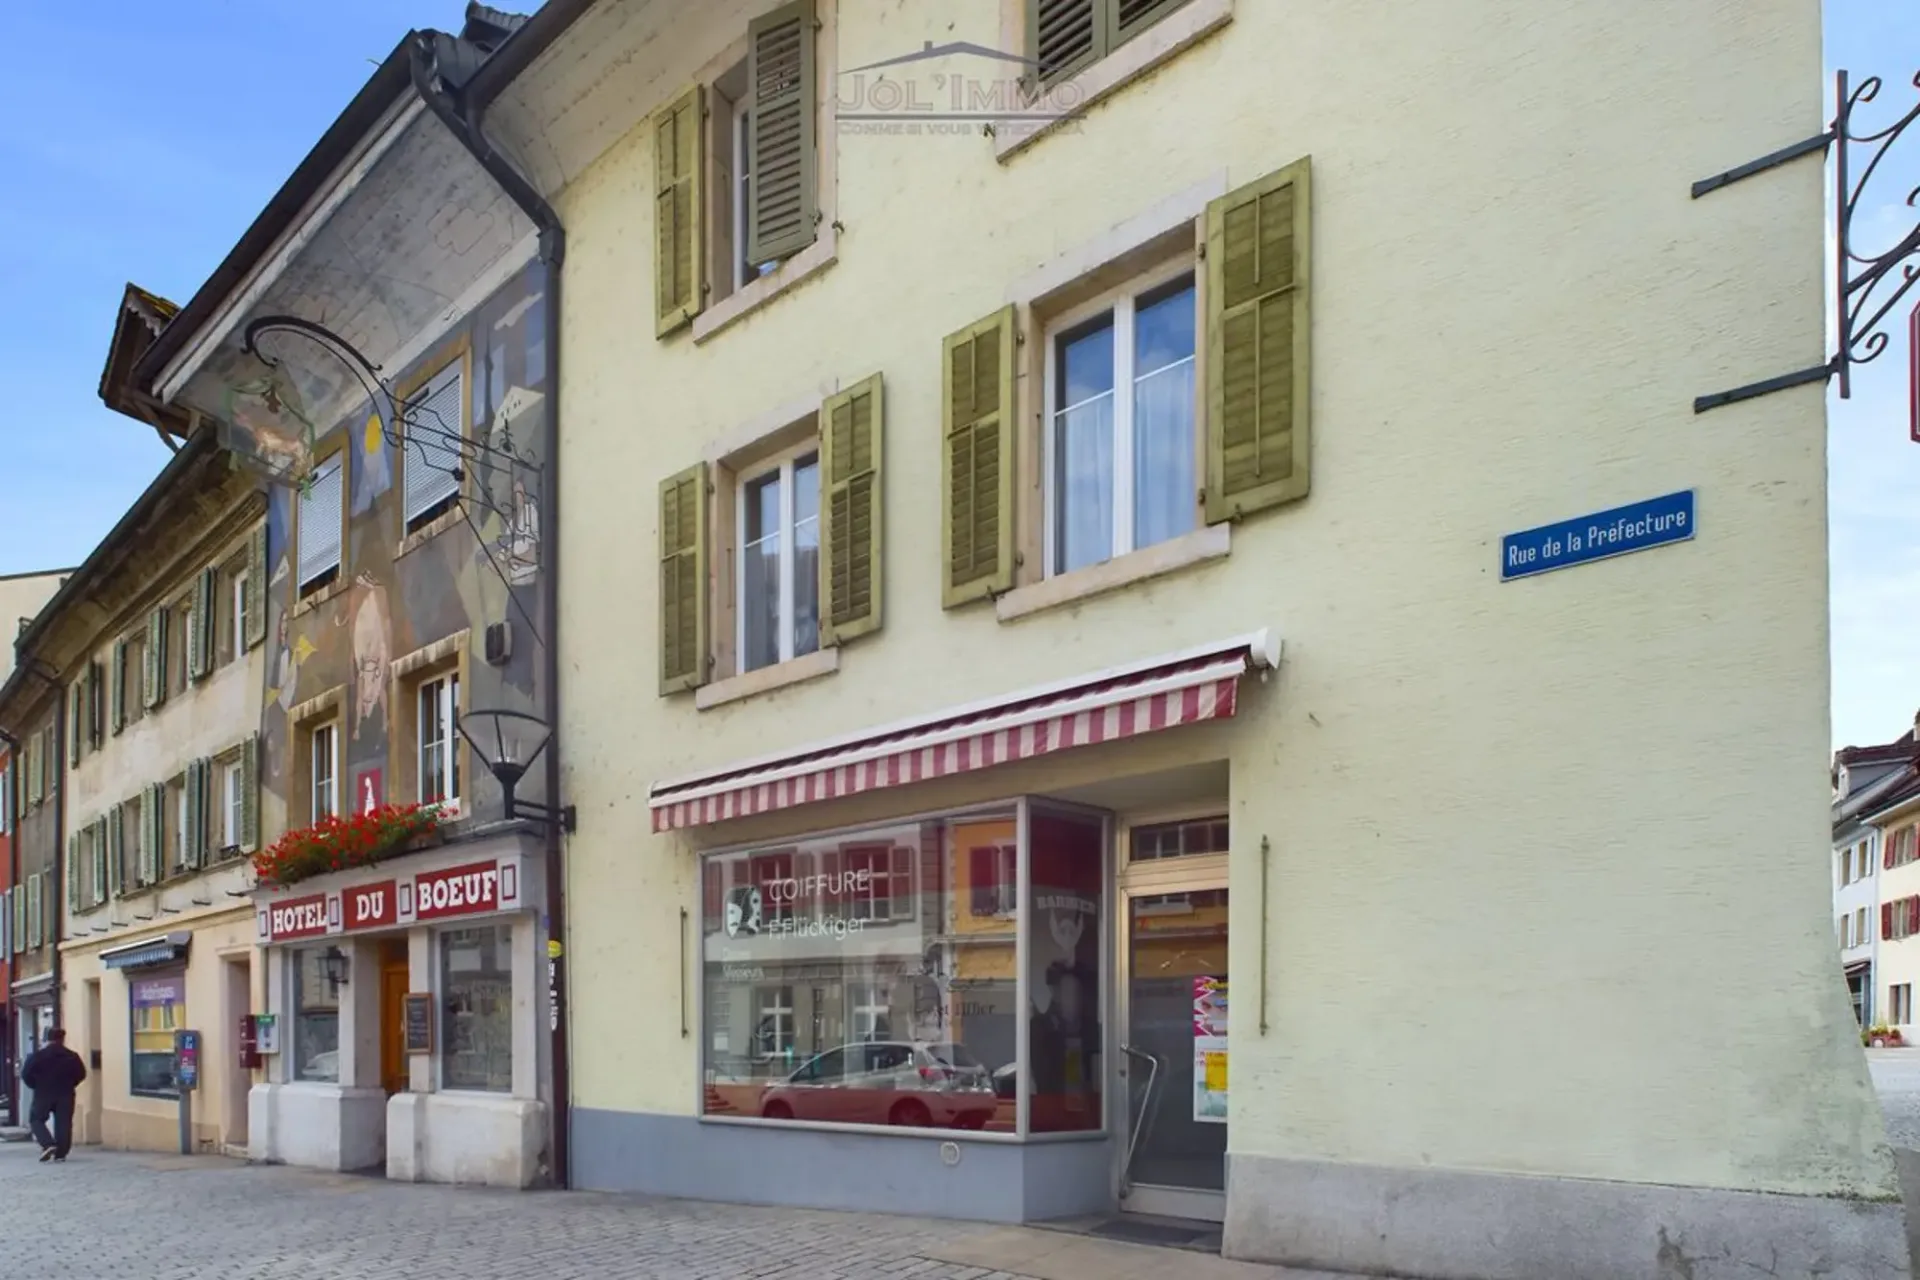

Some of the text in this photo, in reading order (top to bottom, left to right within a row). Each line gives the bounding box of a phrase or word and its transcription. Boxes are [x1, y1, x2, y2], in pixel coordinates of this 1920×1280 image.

[1508, 511, 1687, 567] Rue de la Préfecture
[273, 870, 497, 934] HOTEL DU BOEUF
[768, 868, 871, 901] COIFFURE
